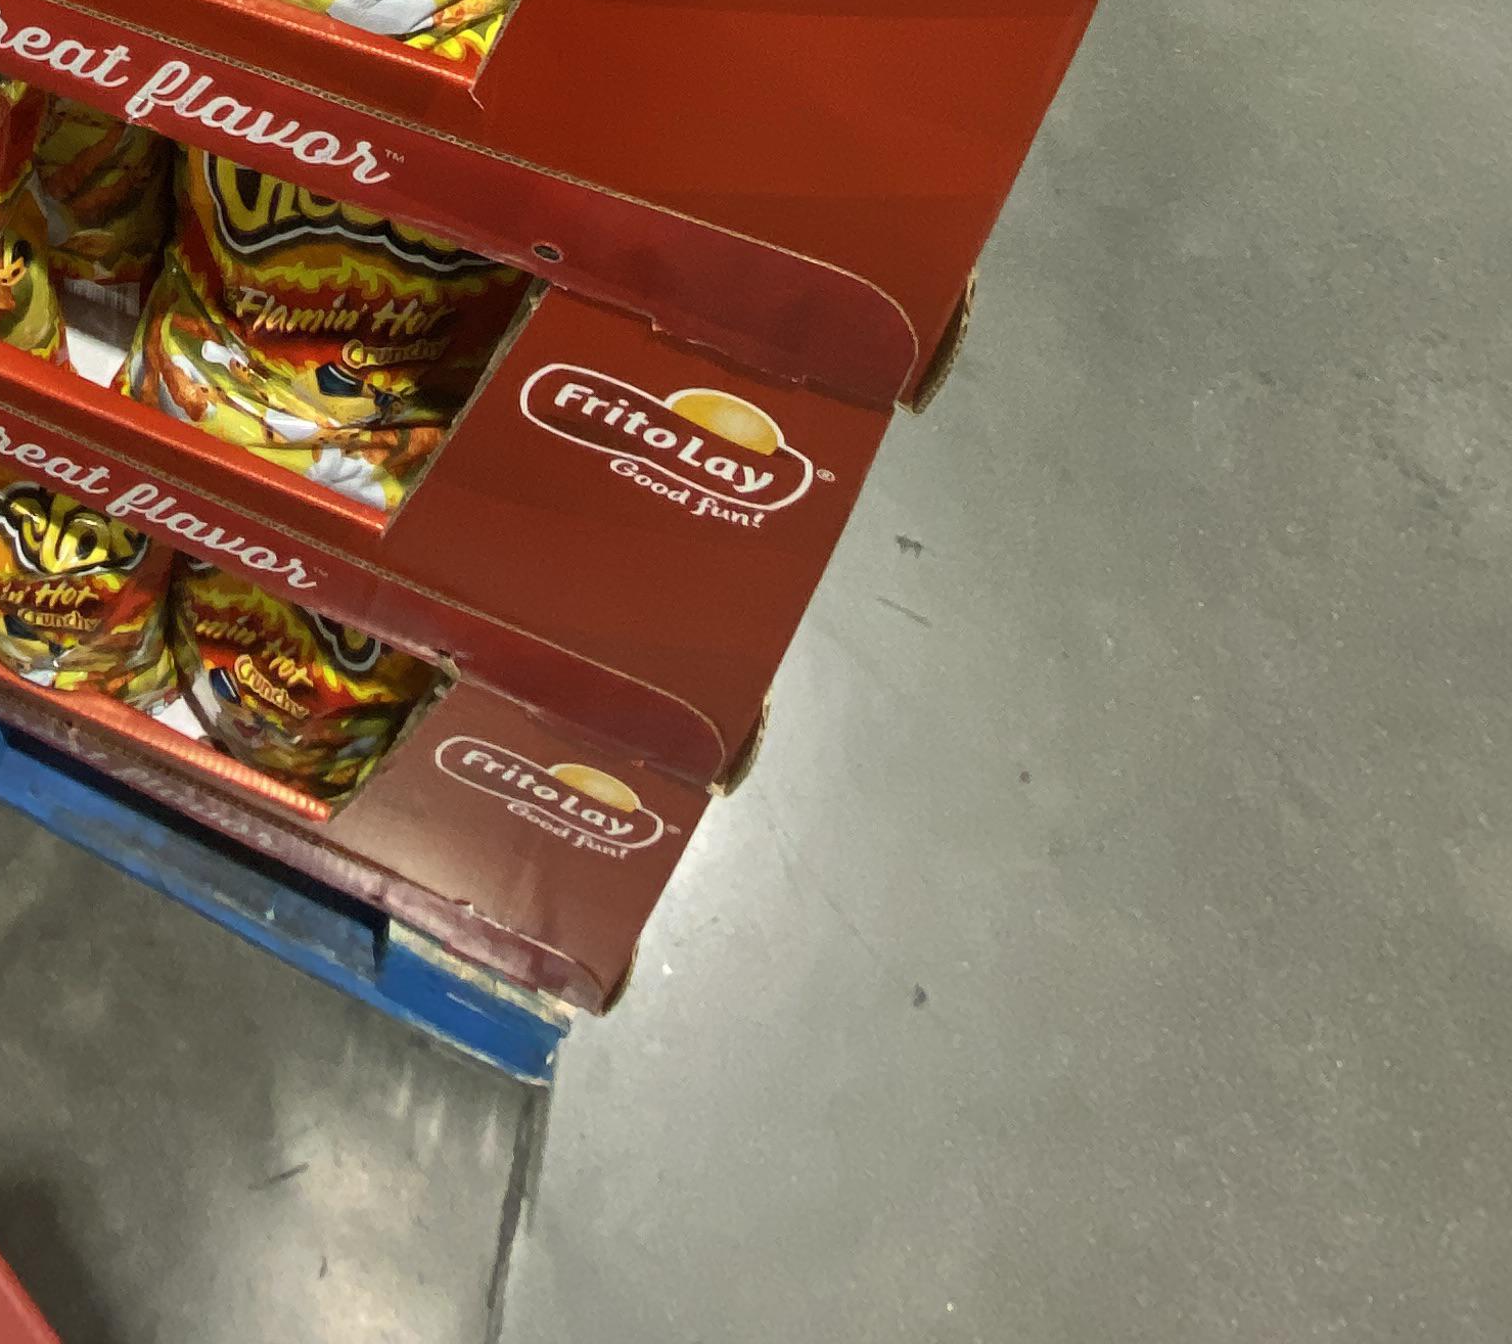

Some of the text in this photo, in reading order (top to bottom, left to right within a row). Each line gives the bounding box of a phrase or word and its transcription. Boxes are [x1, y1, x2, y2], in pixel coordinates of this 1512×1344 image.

[127, 59, 392, 186] flavor
[608, 455, 766, 530] Good fun!
[105, 480, 318, 590] flavor
[35, 581, 100, 608] Hot
[504, 799, 570, 842] Good
